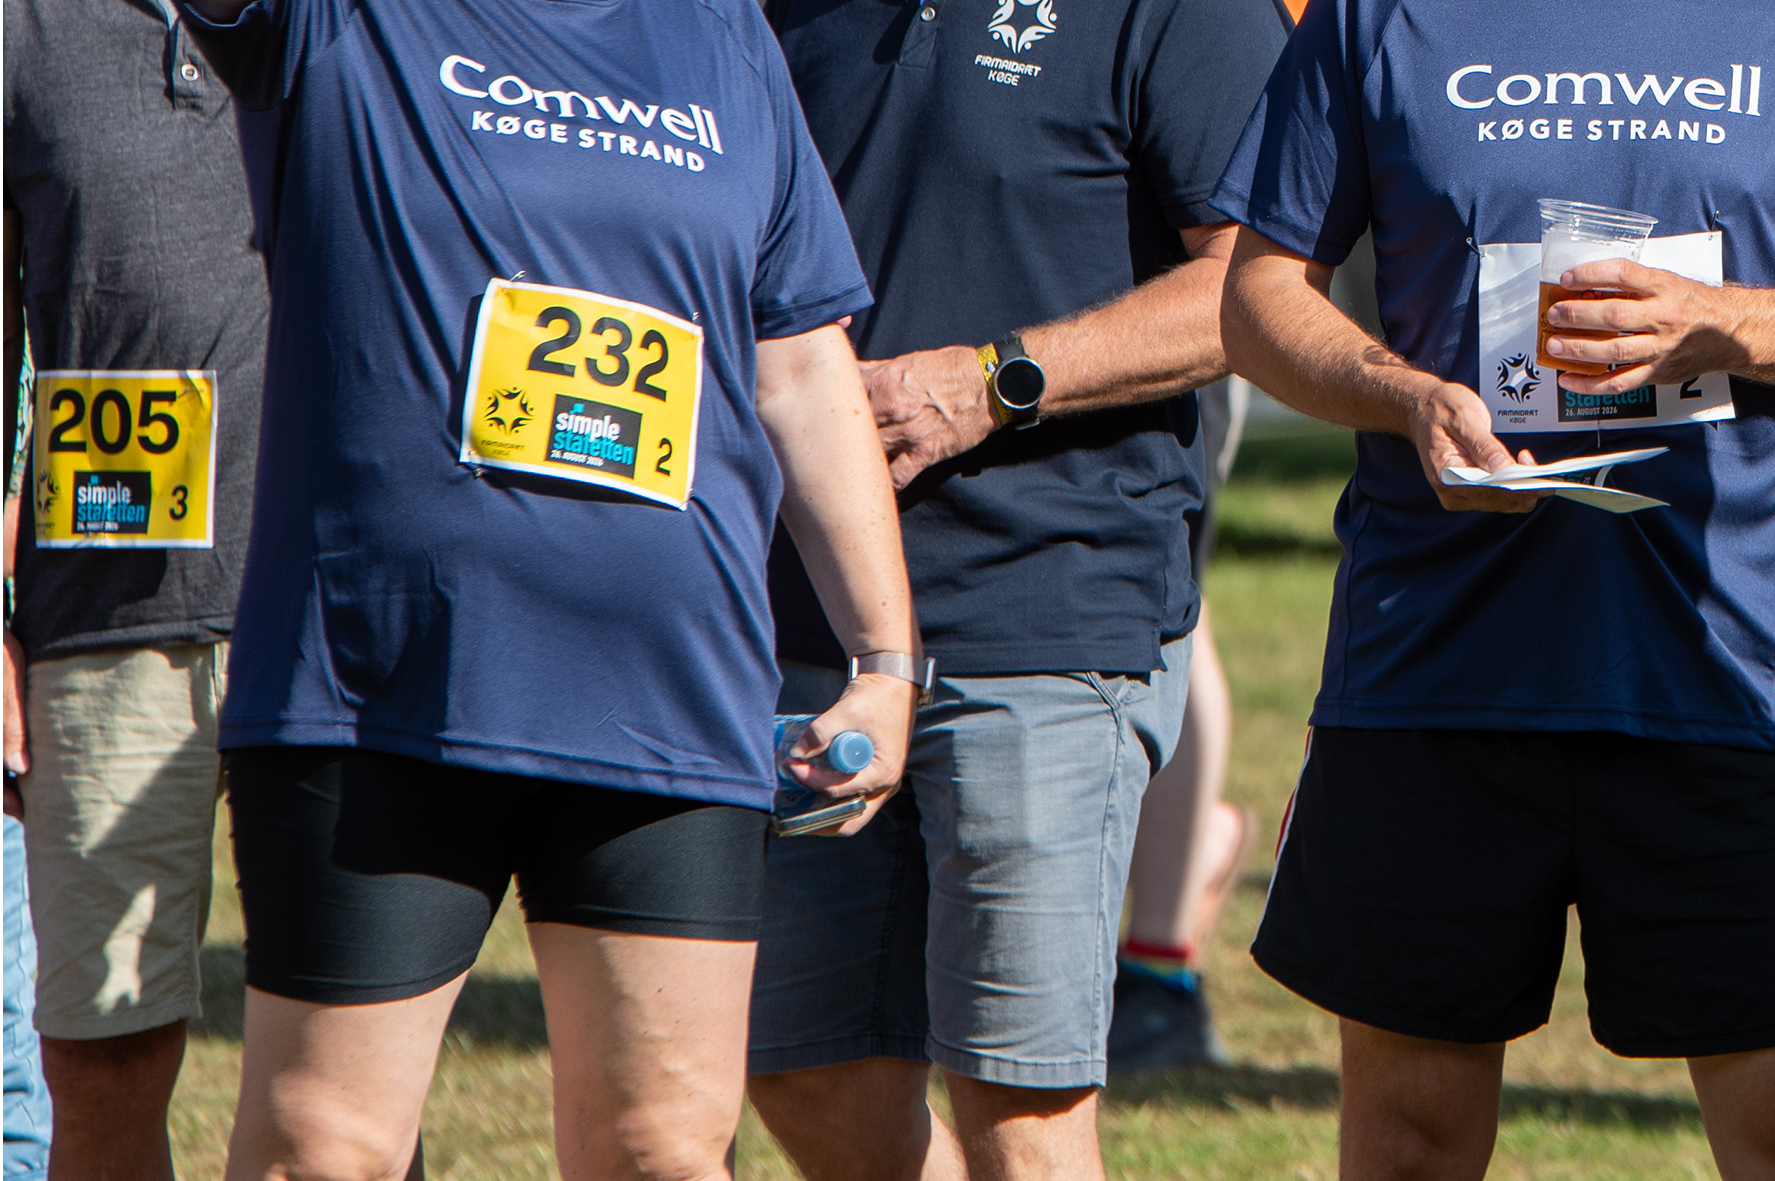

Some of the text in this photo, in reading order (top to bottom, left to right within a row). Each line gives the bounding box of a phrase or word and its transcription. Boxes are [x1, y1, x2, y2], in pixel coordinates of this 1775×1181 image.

[974, 54, 1042, 77] FIRMAIDRÆT
[988, 70, 1020, 86] KØGE
[439, 54, 724, 155] Comwell
[1446, 64, 1761, 117] Comwell
[470, 110, 706, 173] KØGE STRAND
[1477, 119, 1727, 144] KØGE STRAND
[526, 305, 670, 402] 232
[48, 388, 180, 455] 205
[555, 411, 621, 443] simple
[1565, 406, 1618, 417] 26. AUGUST 2026
[553, 430, 635, 466] stafetten
[655, 437, 673, 477] 2
[77, 479, 132, 509] simple
[169, 484, 188, 521] 3
